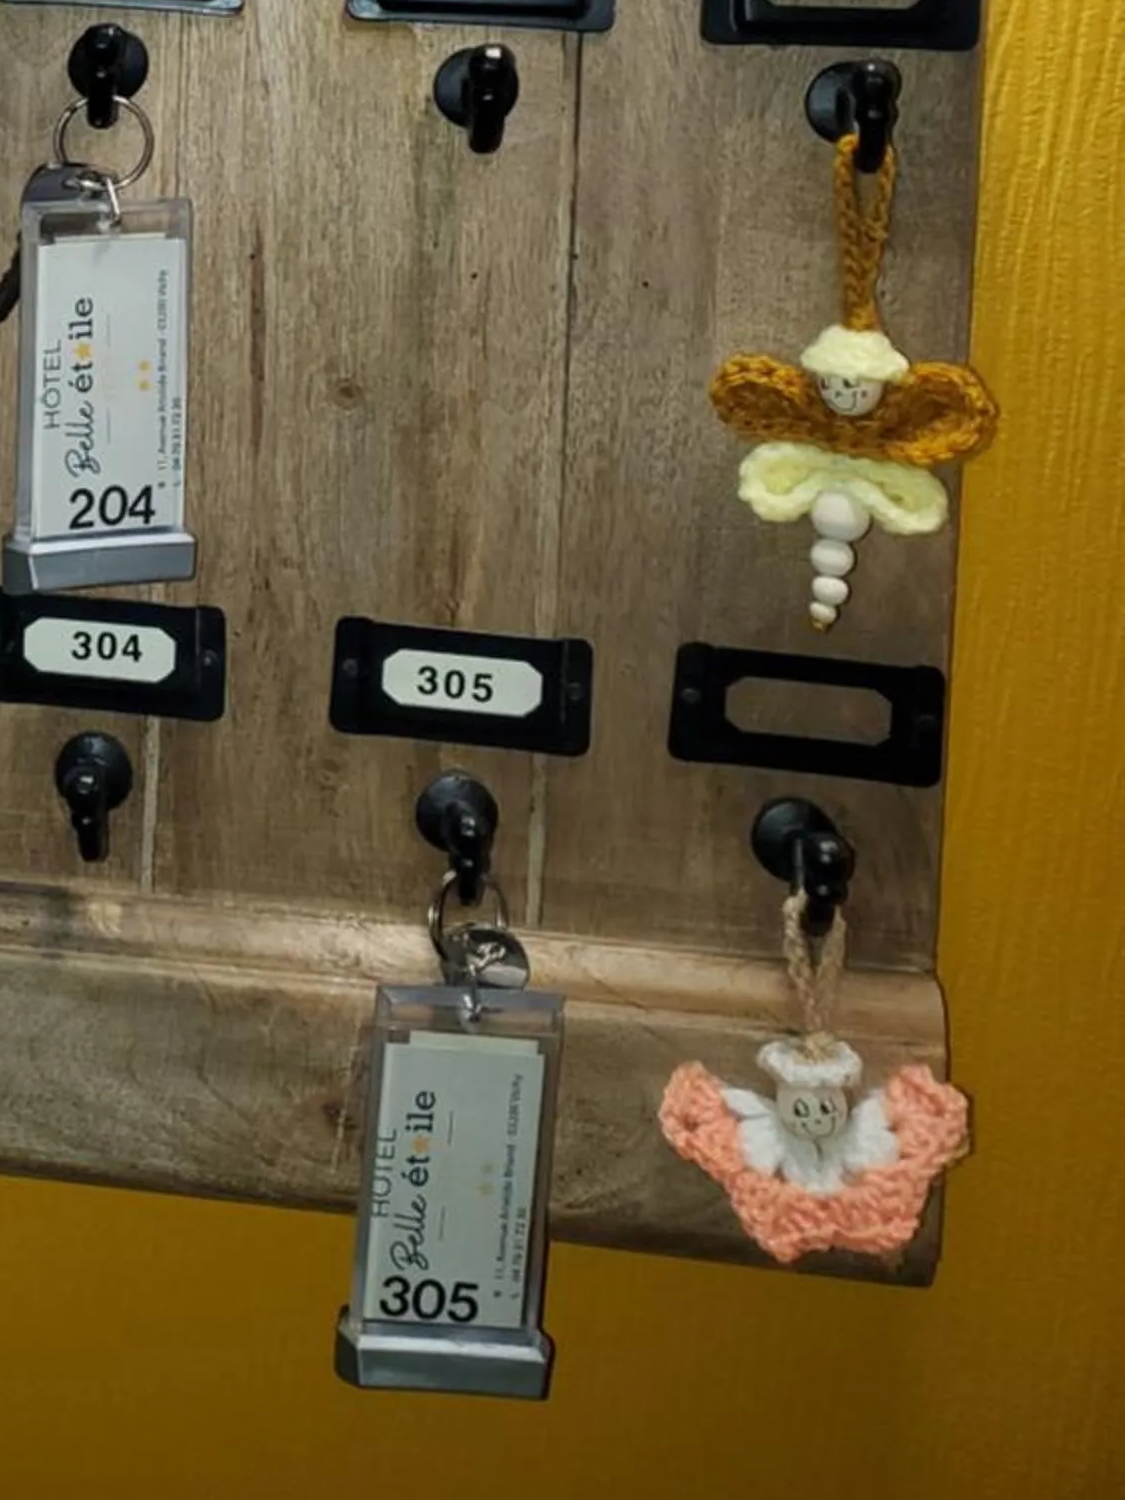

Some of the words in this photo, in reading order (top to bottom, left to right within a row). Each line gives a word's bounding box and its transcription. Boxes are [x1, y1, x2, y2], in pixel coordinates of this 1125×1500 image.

[69, 297, 93, 392] étile
[65, 401, 100, 478] Belle
[69, 484, 155, 529] 204
[72, 632, 142, 662] 304
[418, 666, 493, 702] 305
[401, 1090, 436, 1187] étile
[389, 1194, 429, 1271] Belle
[380, 1275, 479, 1323] 305
